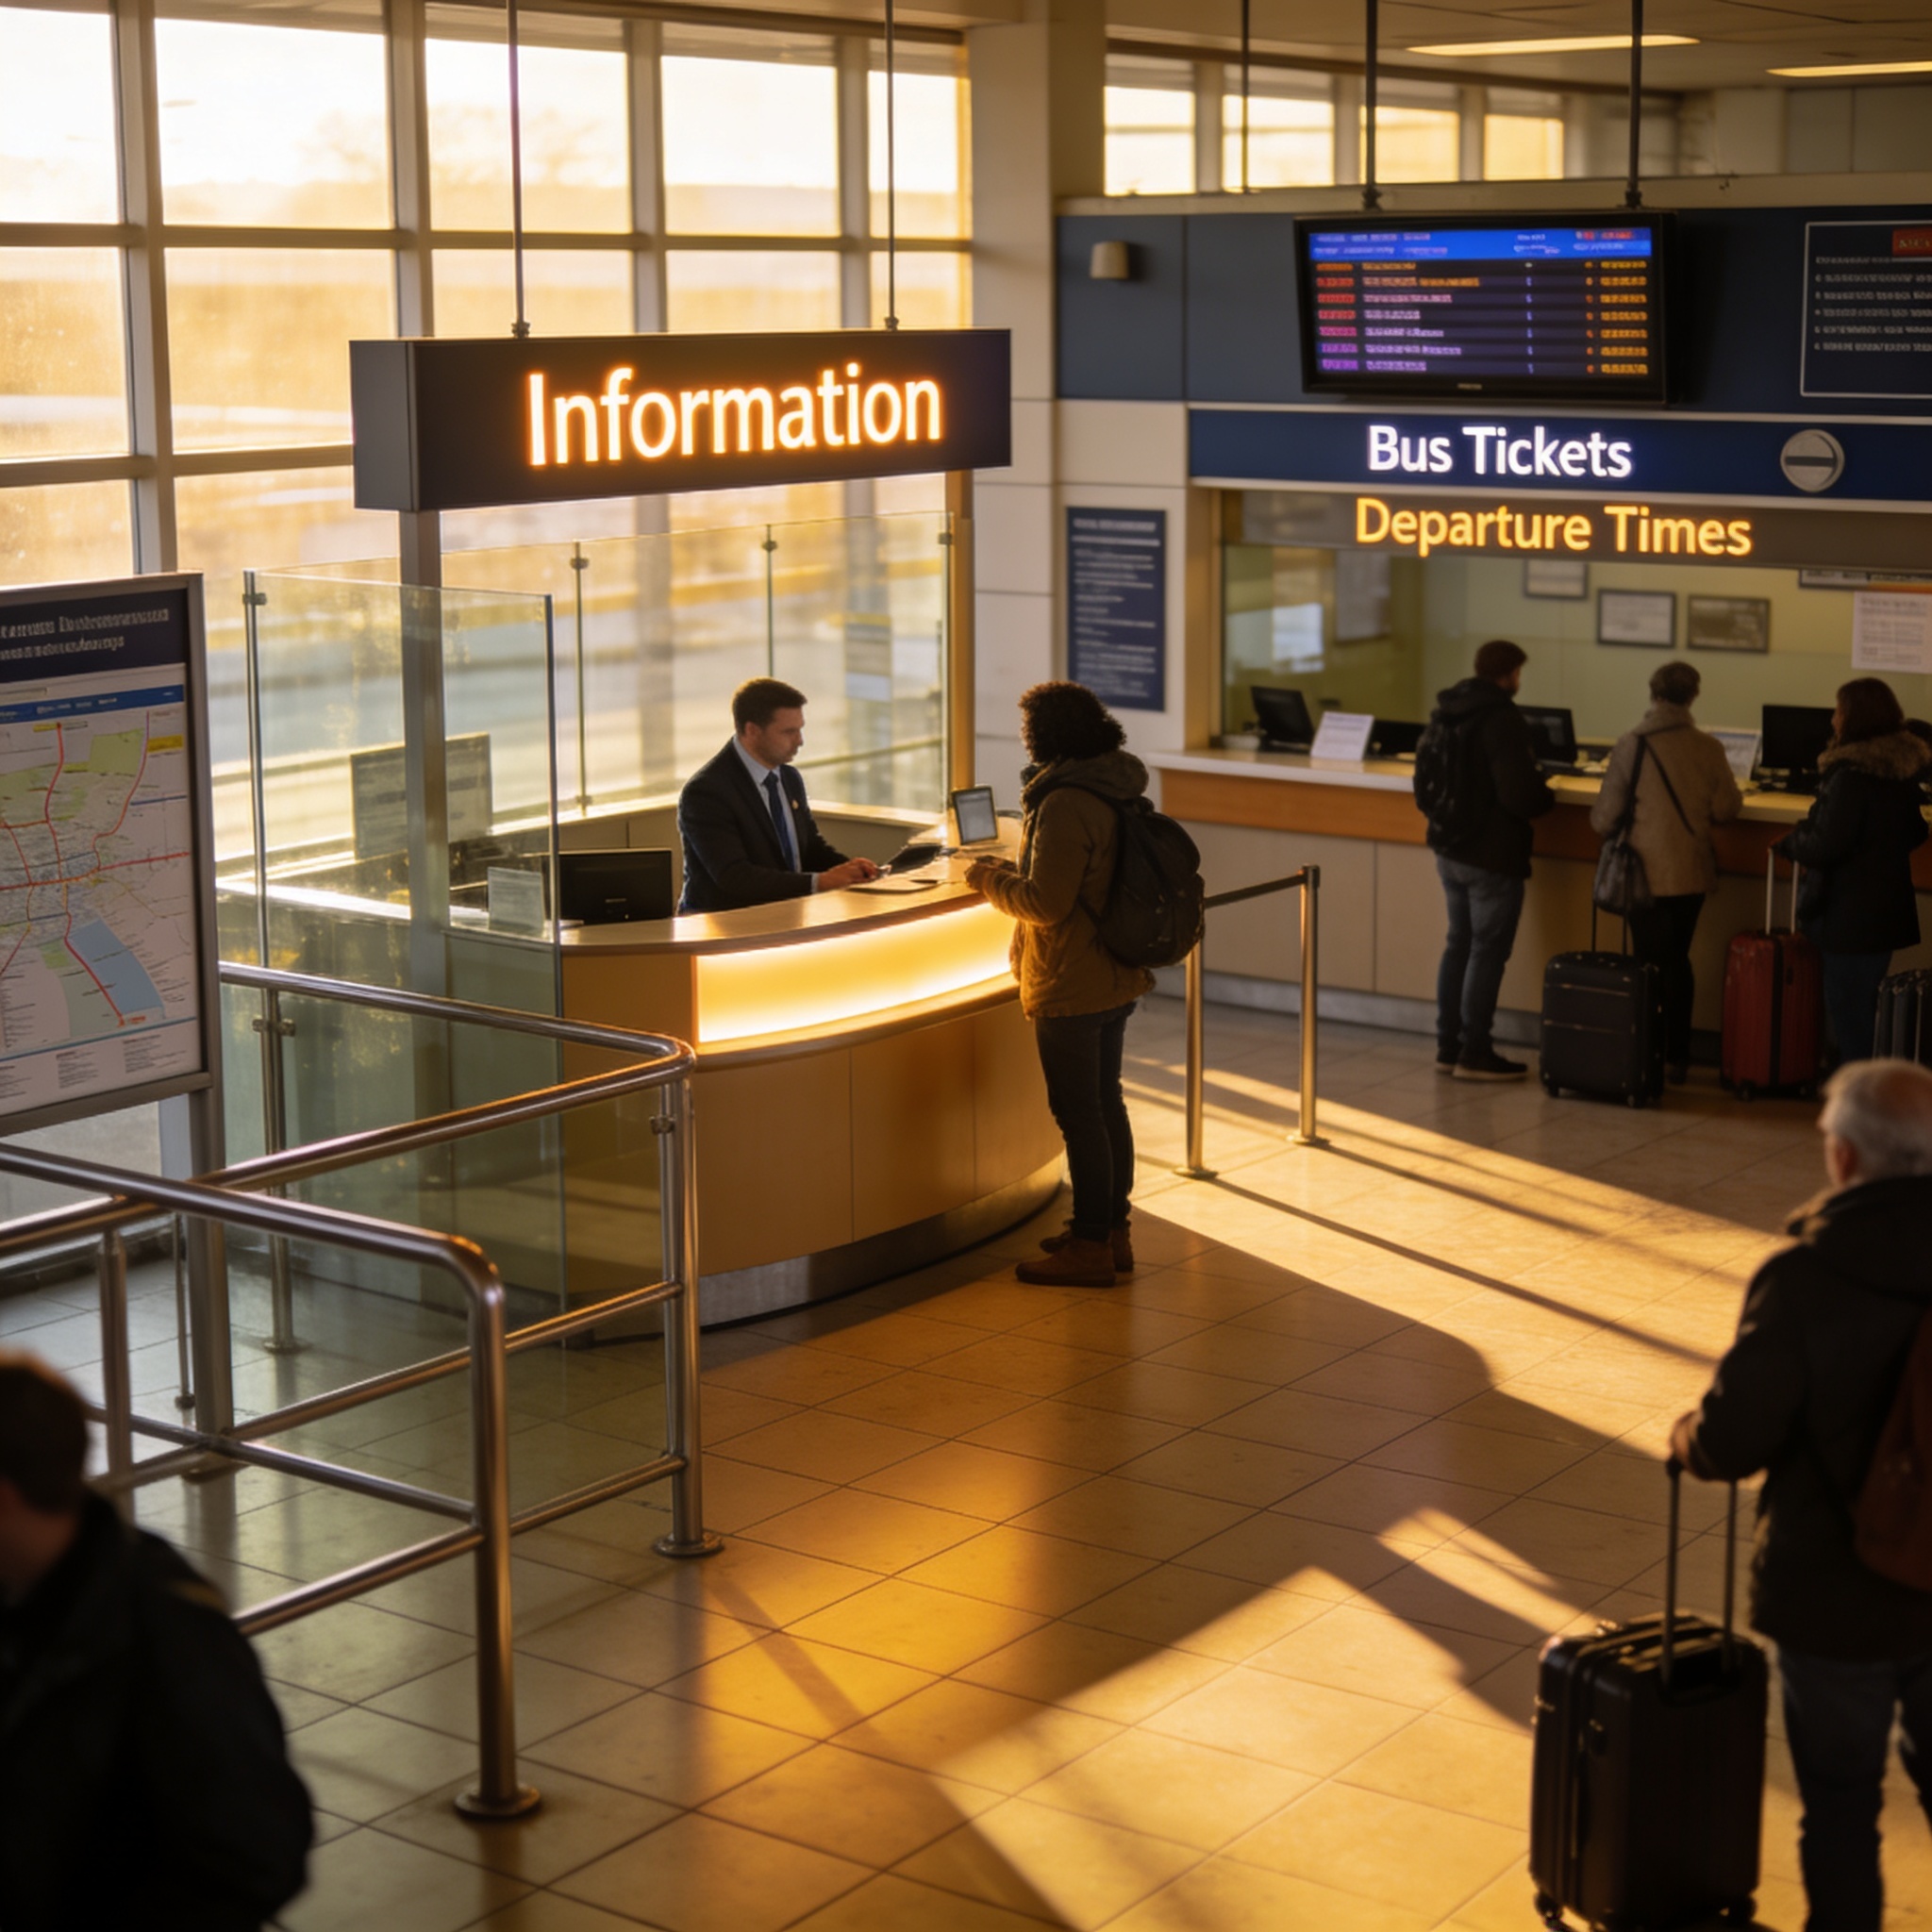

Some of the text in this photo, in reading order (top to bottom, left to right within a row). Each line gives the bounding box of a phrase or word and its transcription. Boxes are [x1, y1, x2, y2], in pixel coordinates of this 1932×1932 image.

[528, 361, 941, 466] Information
[1368, 424, 1633, 478] Bus Tickets
[1355, 496, 1754, 558] Departure Times
